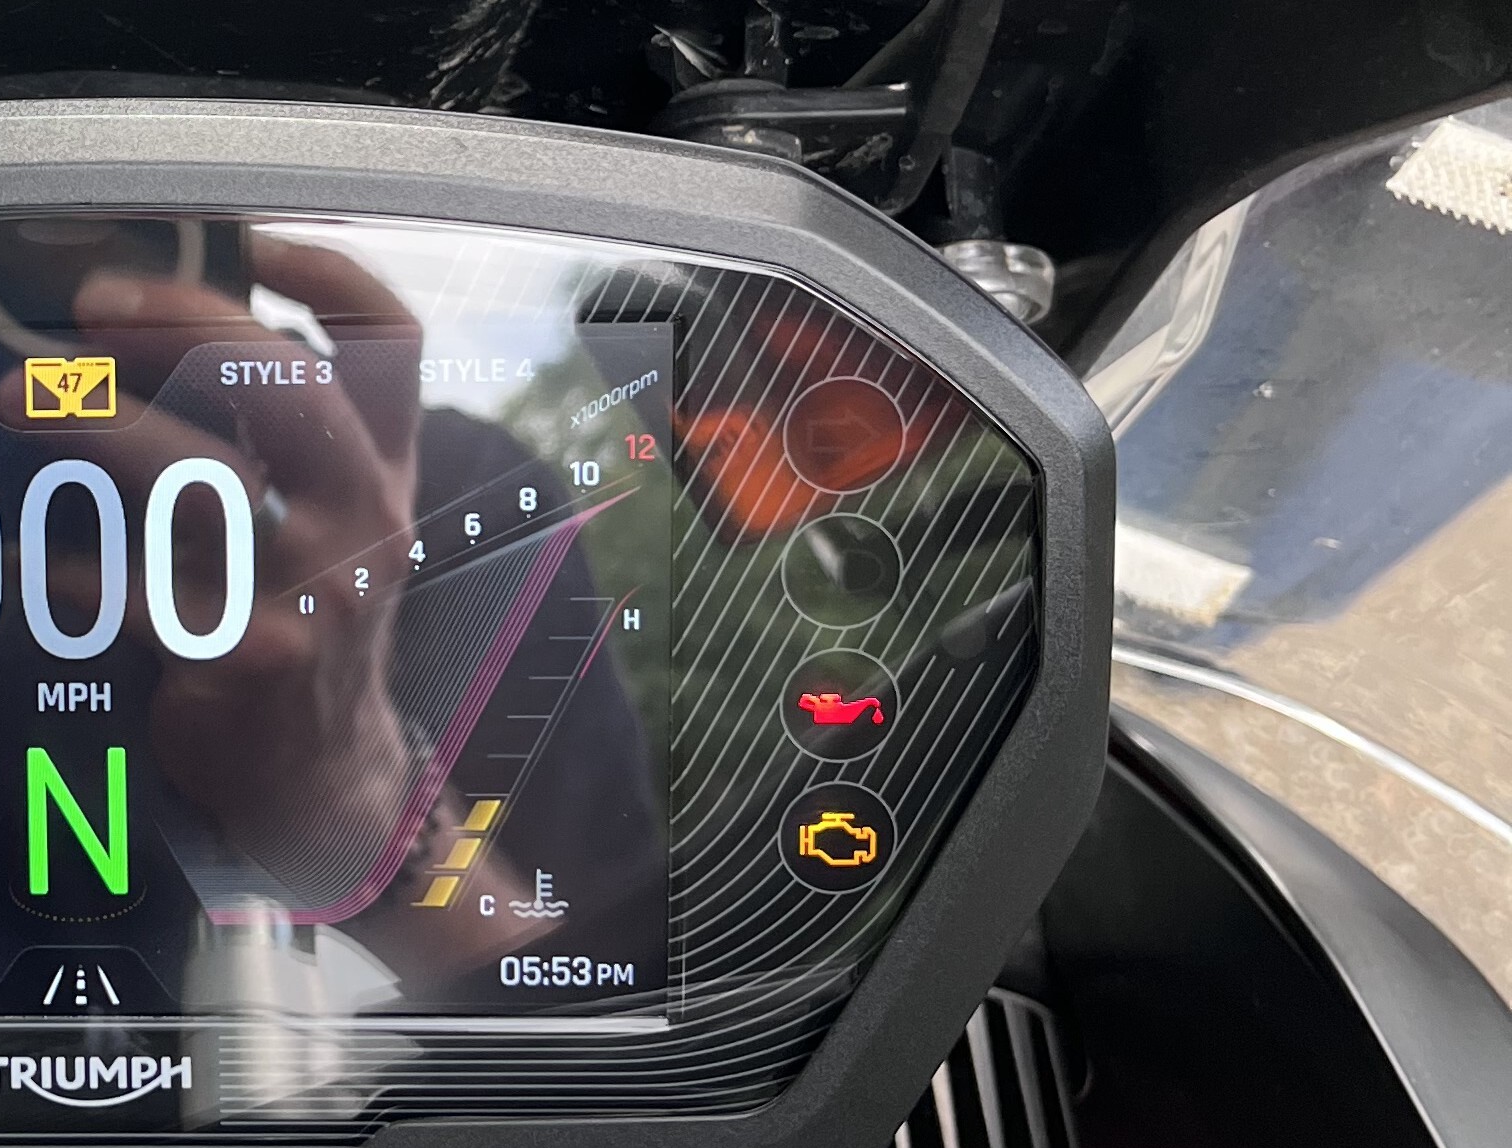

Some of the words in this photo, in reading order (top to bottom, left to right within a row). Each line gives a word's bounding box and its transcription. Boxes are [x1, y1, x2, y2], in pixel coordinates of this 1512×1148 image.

[220, 361, 305, 386] STYLE
[315, 361, 334, 385] 3
[419, 358, 505, 382] STYLE
[516, 357, 535, 381] 4
[57, 373, 83, 393] 47
[570, 368, 659, 429] x1000rpm
[624, 433, 656, 461] 12
[569, 461, 600, 486] 10
[518, 487, 537, 511] 8
[463, 513, 481, 536] 6
[408, 540, 426, 563] 4
[354, 567, 369, 589] 2
[623, 608, 641, 631] H
[37, 681, 112, 713] MPH
[26, 746, 129, 895] N
[479, 894, 495, 917] C
[500, 955, 592, 988] 05:53
[596, 962, 635, 987] PM
